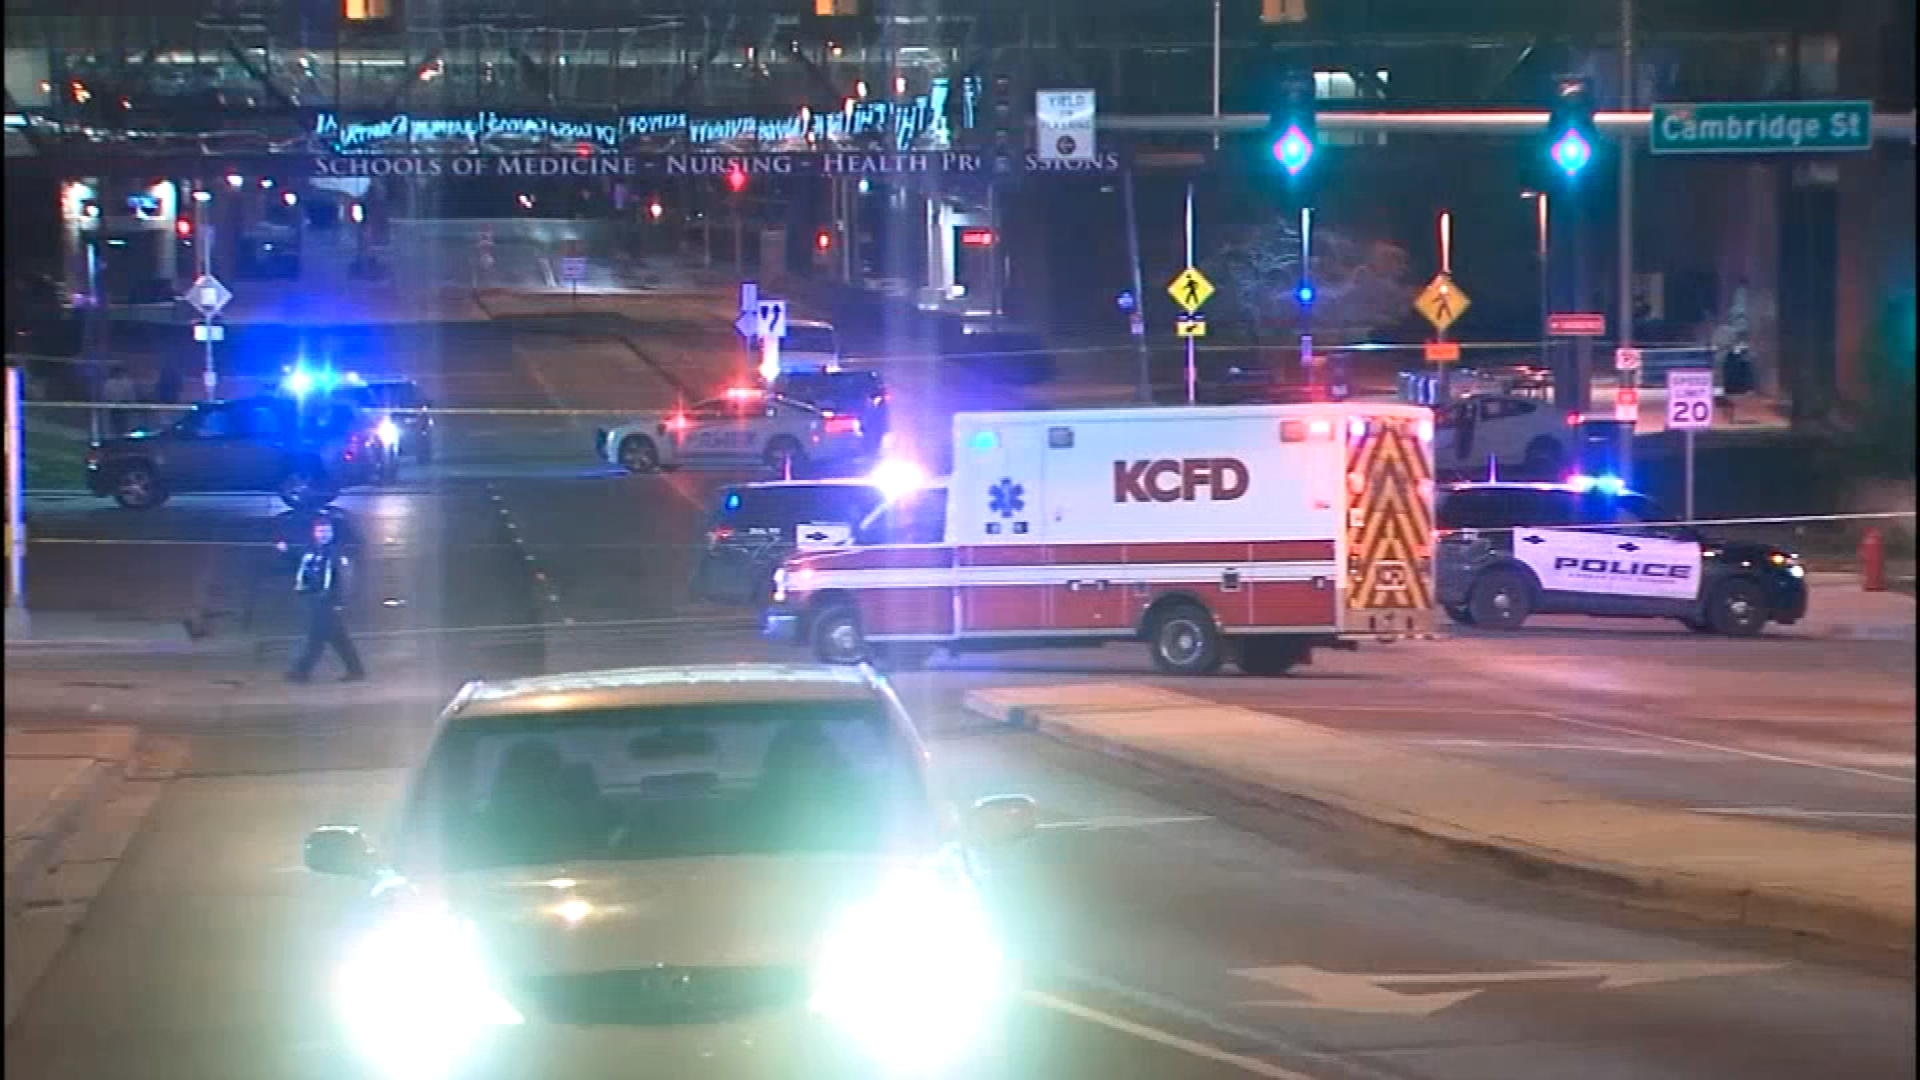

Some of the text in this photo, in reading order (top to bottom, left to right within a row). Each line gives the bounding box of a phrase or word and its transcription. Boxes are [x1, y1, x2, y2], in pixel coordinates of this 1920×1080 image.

[1661, 111, 1862, 145] Cambridge St
[314, 157, 442, 175] SCHOOLS
[452, 157, 489, 175] OF
[498, 156, 637, 175] MEDICINE
[666, 154, 792, 174] NURSING
[822, 153, 928, 173] HEALTH
[1673, 401, 1709, 423] 20
[1113, 457, 1250, 503] KCFD
[1554, 556, 1693, 580] POLICE
